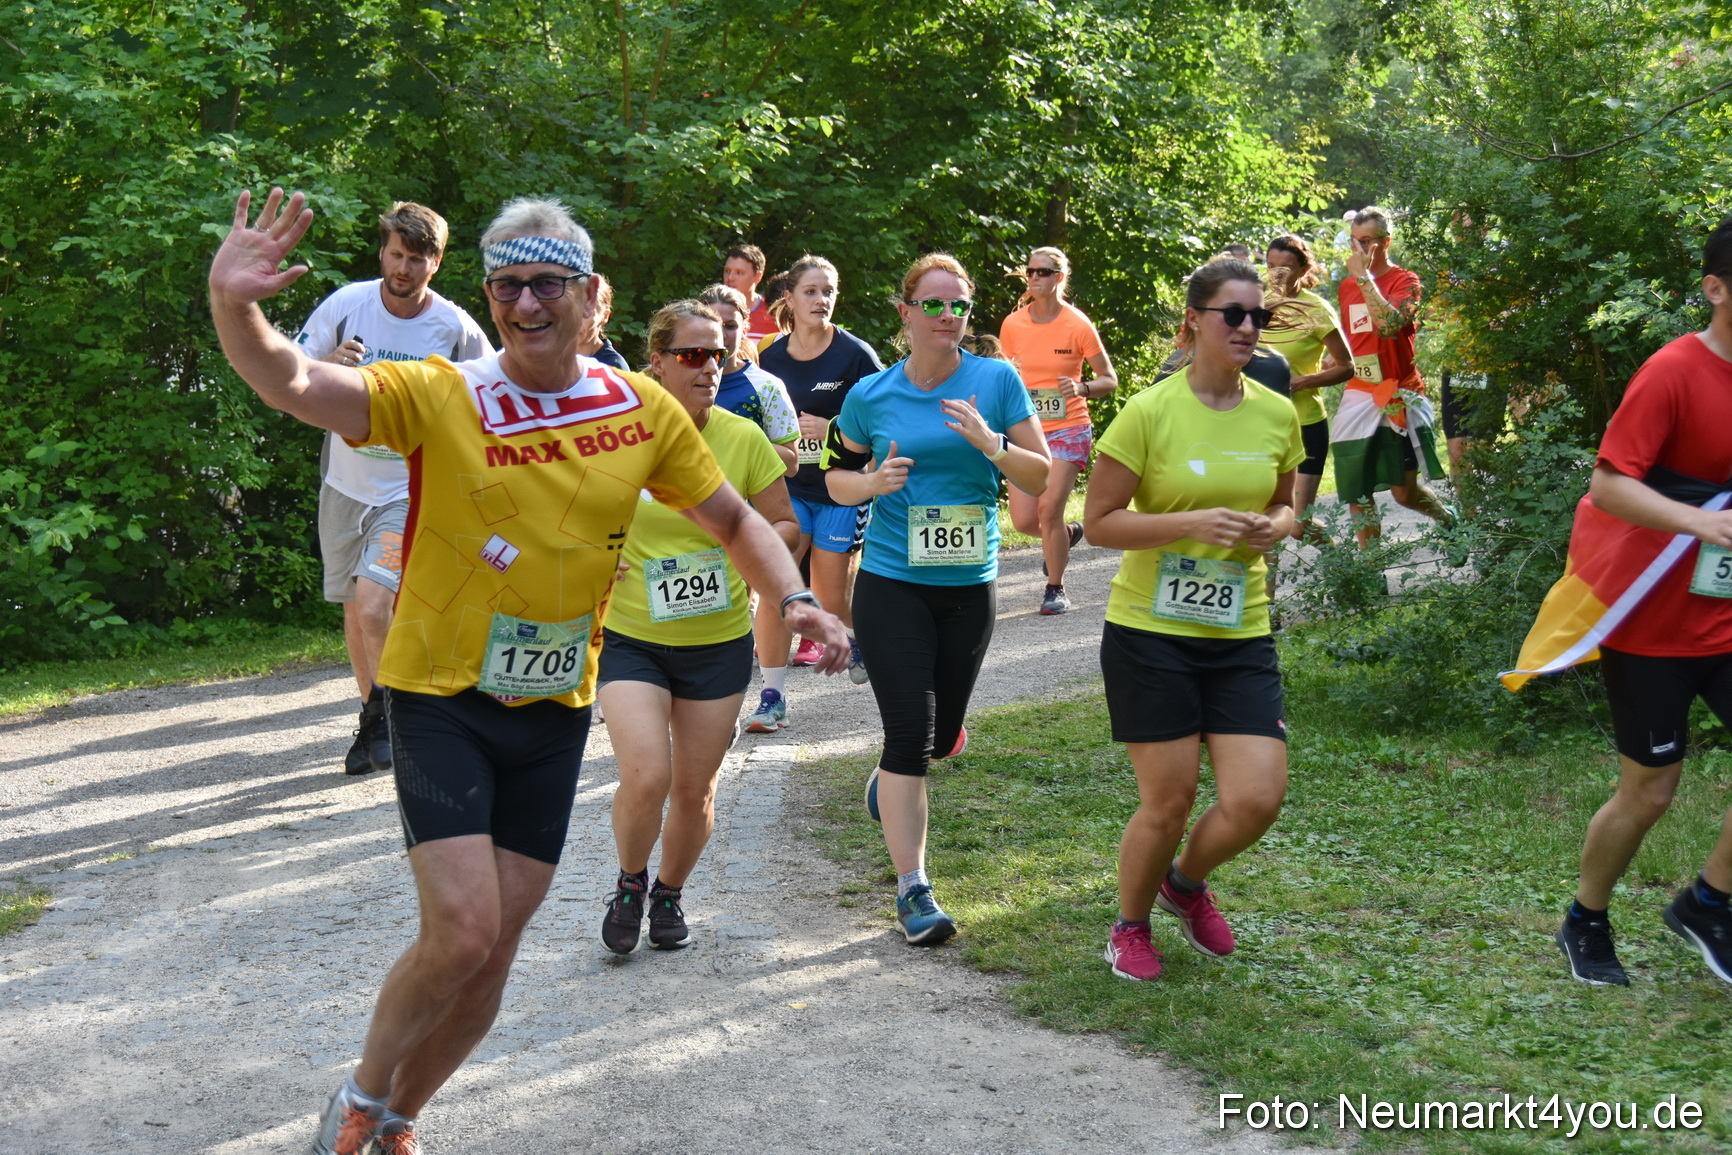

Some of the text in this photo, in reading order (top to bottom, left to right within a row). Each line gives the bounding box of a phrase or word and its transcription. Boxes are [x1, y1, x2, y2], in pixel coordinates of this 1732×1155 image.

[1355, 366, 1371, 377] 78
[1032, 399, 1060, 411] 319
[485, 421, 654, 468] MAX BÖGL
[919, 526, 975, 548] 1861
[658, 572, 720, 603] 1294
[1168, 578, 1233, 609] 1228
[666, 596, 716, 610] Simon Elisabeth
[1165, 601, 1230, 616] Gottschalk Barbara
[501, 646, 577, 676] 1708
